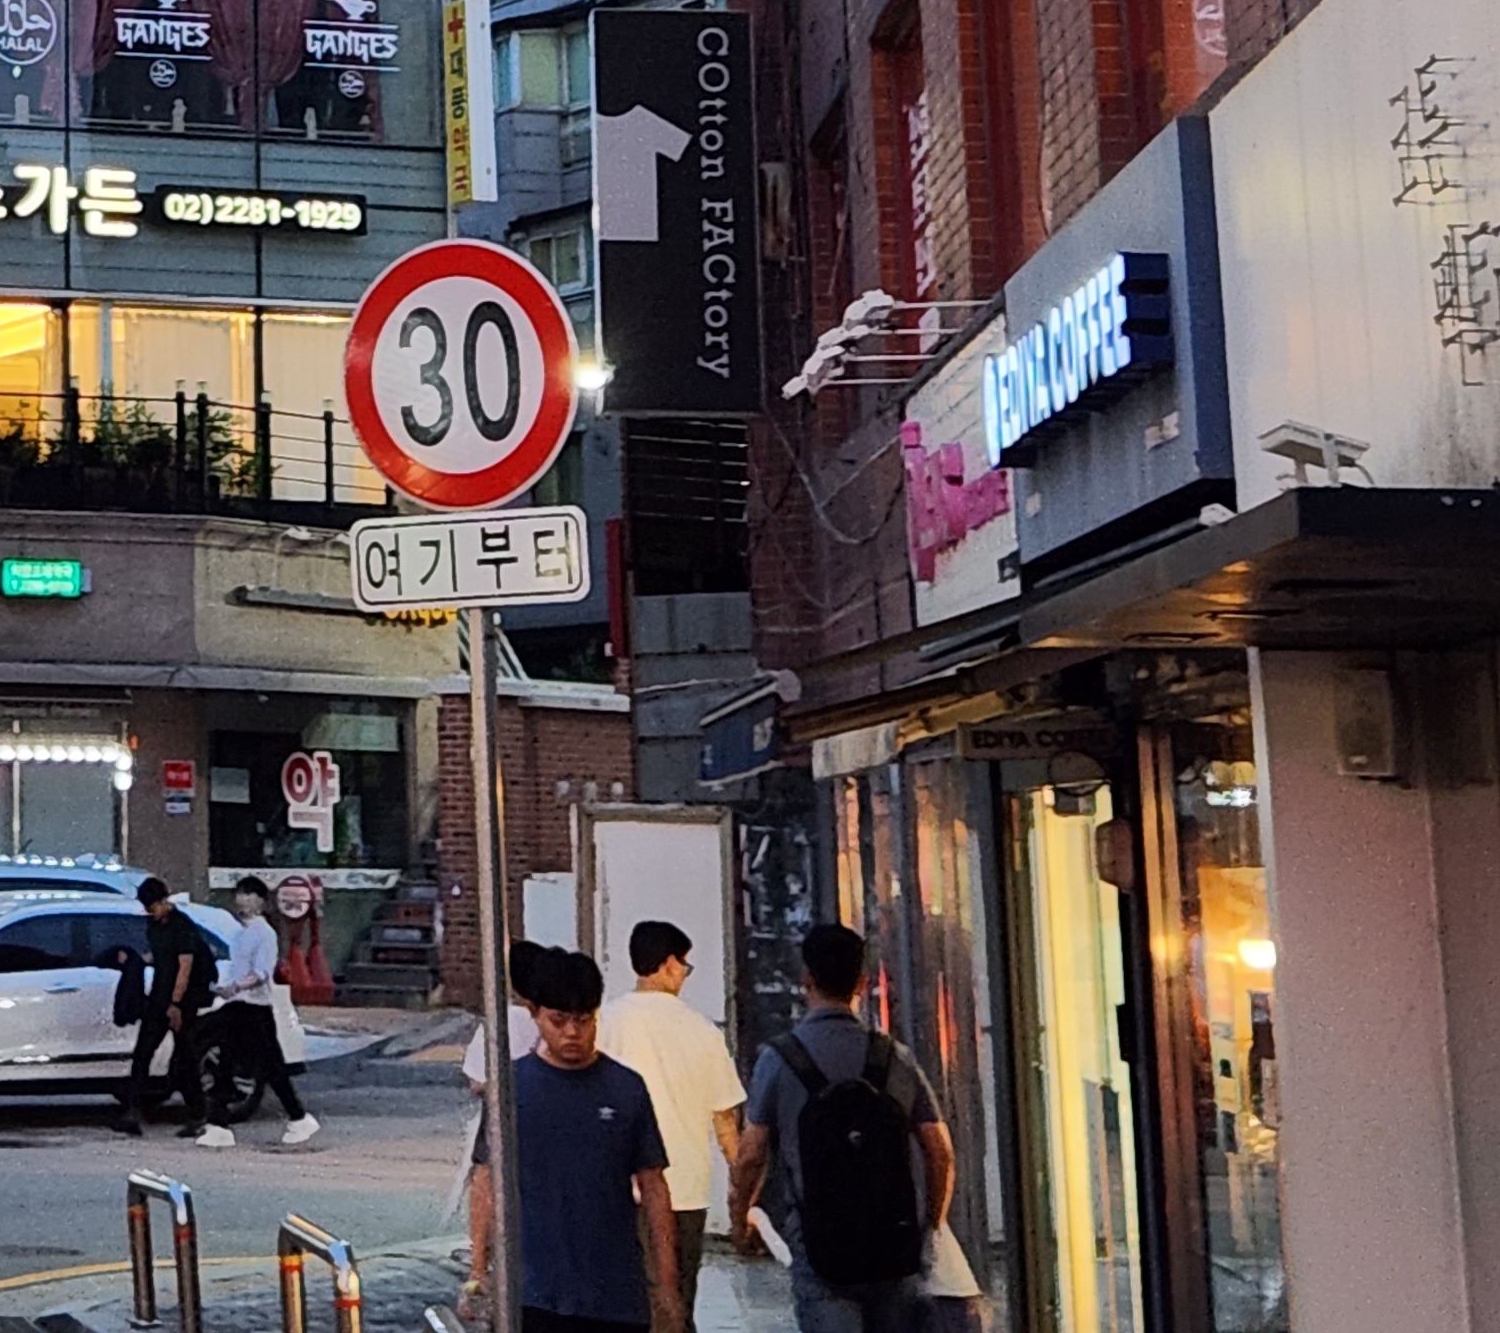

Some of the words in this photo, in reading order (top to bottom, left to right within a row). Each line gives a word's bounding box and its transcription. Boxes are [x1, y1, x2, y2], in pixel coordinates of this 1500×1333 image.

[114, 16, 211, 52] GANGES
[304, 29, 399, 63] GANGES
[163, 193, 363, 231] 02)2281-1929
[1050, 252, 1132, 412] COFFEE
[399, 300, 521, 447] 30
[365, 520, 574, 596] 여기부터
[280, 750, 342, 853] 약
